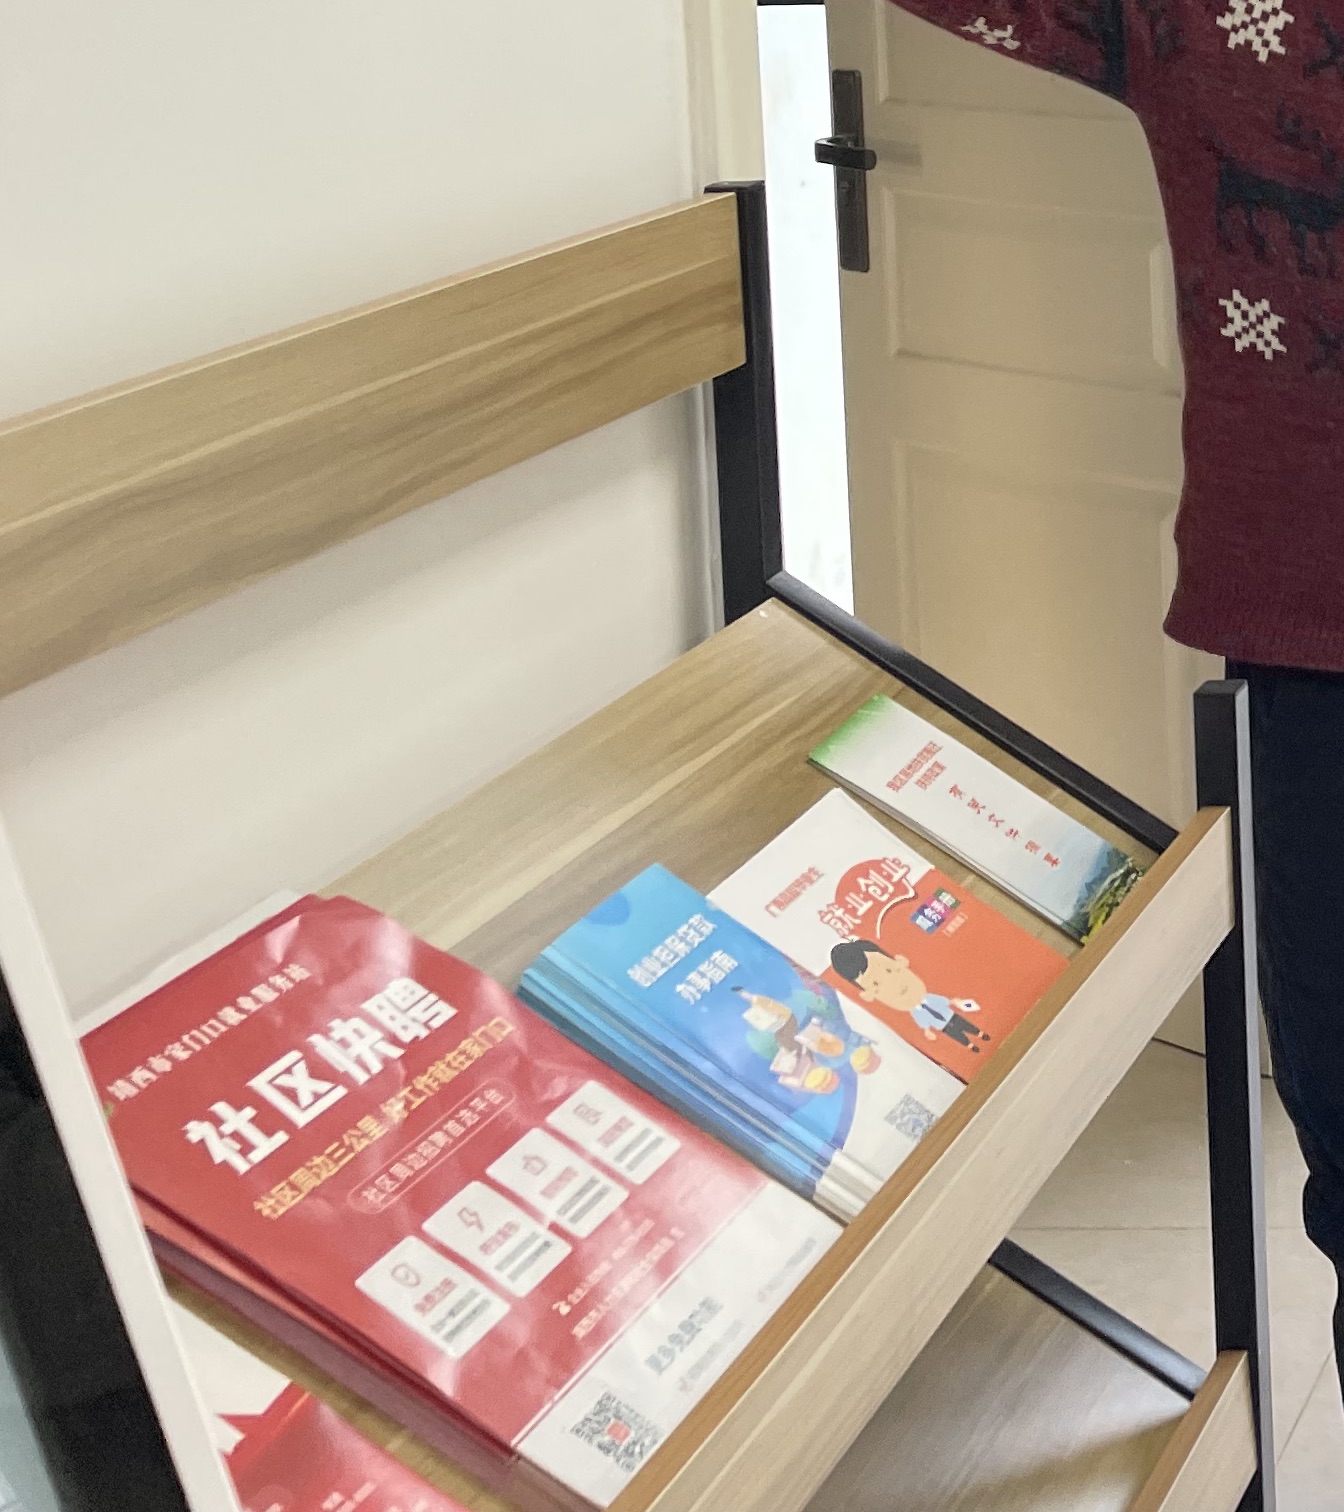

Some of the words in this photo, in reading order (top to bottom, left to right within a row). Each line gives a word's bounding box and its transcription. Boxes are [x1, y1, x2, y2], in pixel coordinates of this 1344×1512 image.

[818, 857, 912, 939] 就业创业
[627, 913, 718, 987] 创业担保贷款
[676, 949, 739, 1005] 办事指南
[182, 976, 459, 1175] 社区快聘
[253, 1115, 388, 1220] 社区周边三公里
[379, 1017, 517, 1128] 好工作就在家门口
[361, 1088, 505, 1204] 社区周边招聘首选平台
